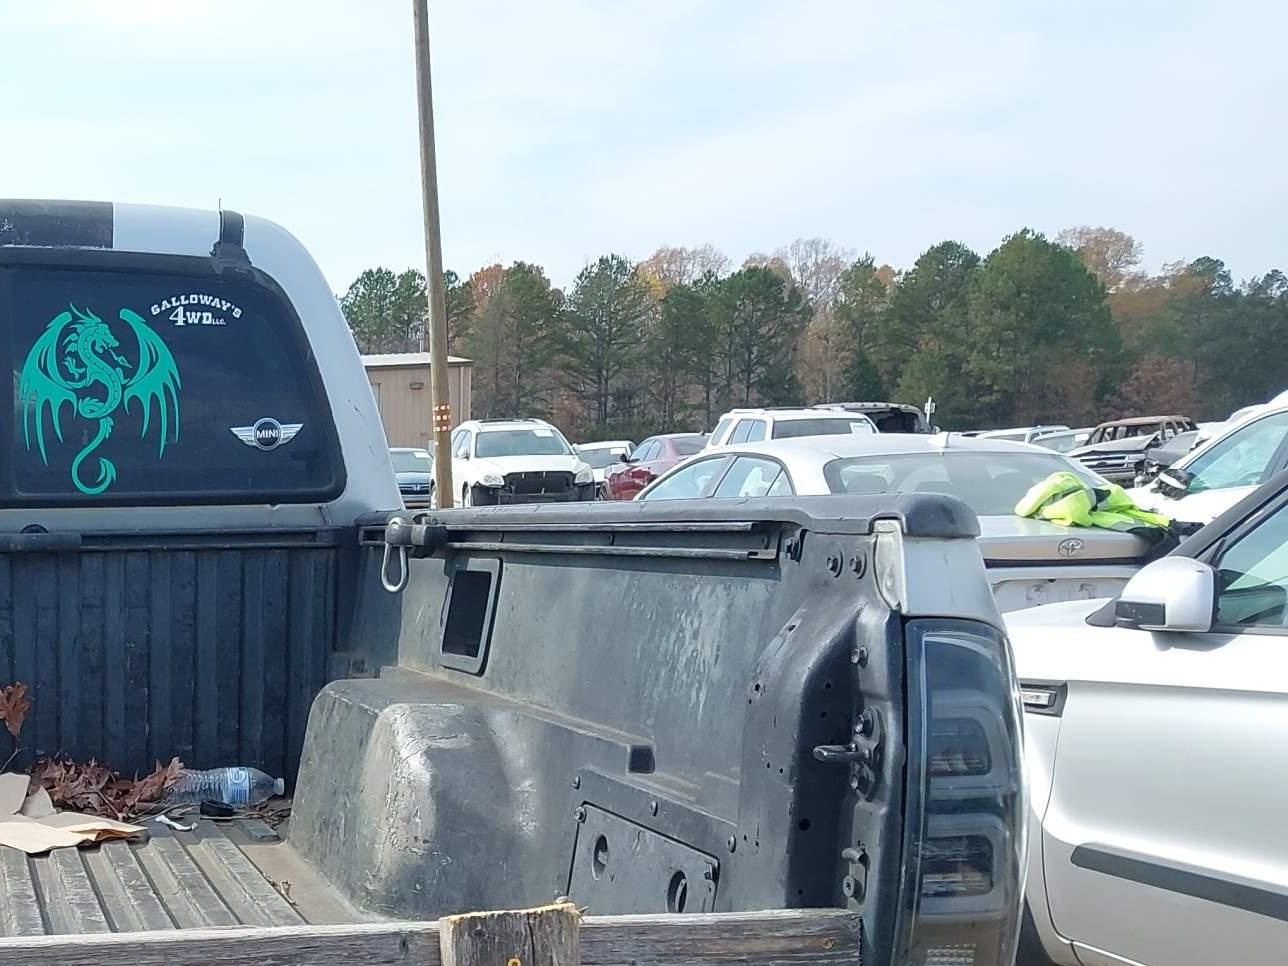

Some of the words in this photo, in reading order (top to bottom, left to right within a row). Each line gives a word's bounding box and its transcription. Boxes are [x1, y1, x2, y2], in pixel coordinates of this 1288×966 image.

[150, 294, 242, 319] GALLOWAY'S
[169, 306, 212, 326] 4WD
[256, 428, 279, 439] MINI
